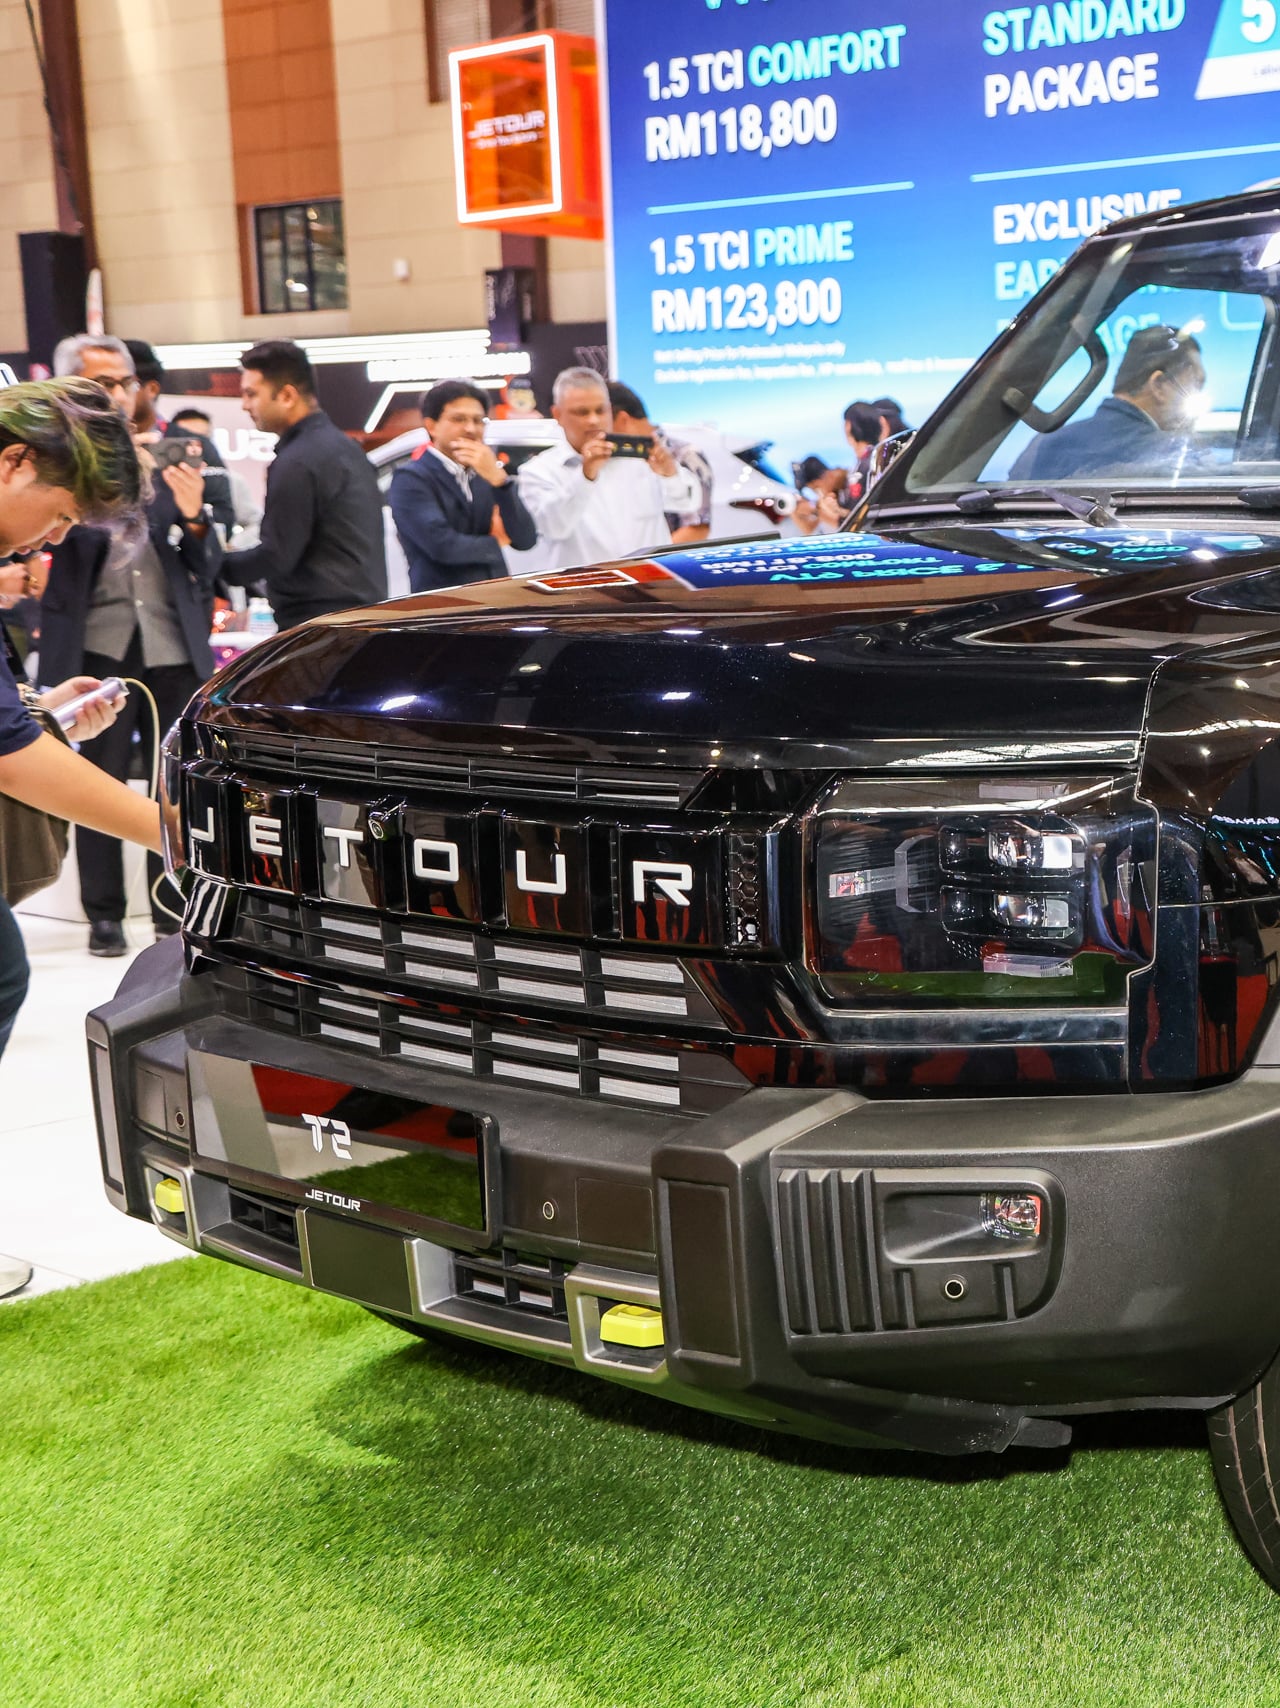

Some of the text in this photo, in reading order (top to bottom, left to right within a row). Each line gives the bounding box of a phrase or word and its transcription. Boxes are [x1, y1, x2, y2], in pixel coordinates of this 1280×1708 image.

[982, 0, 1186, 56] STANDARD
[1240, 0, 1277, 43] 5
[643, 24, 907, 101] 1.5 TCI COMFORT
[984, 52, 1160, 118] PACKAGE
[467, 110, 546, 139] JETOUR
[645, 94, 838, 162] RM118,800
[650, 220, 854, 275] 1.5 TCI PRIME
[651, 277, 842, 335] RM123,800
[191, 807, 693, 906] JETOUR
[301, 1112, 353, 1160] T2
[305, 1188, 361, 1212] JETOUR
